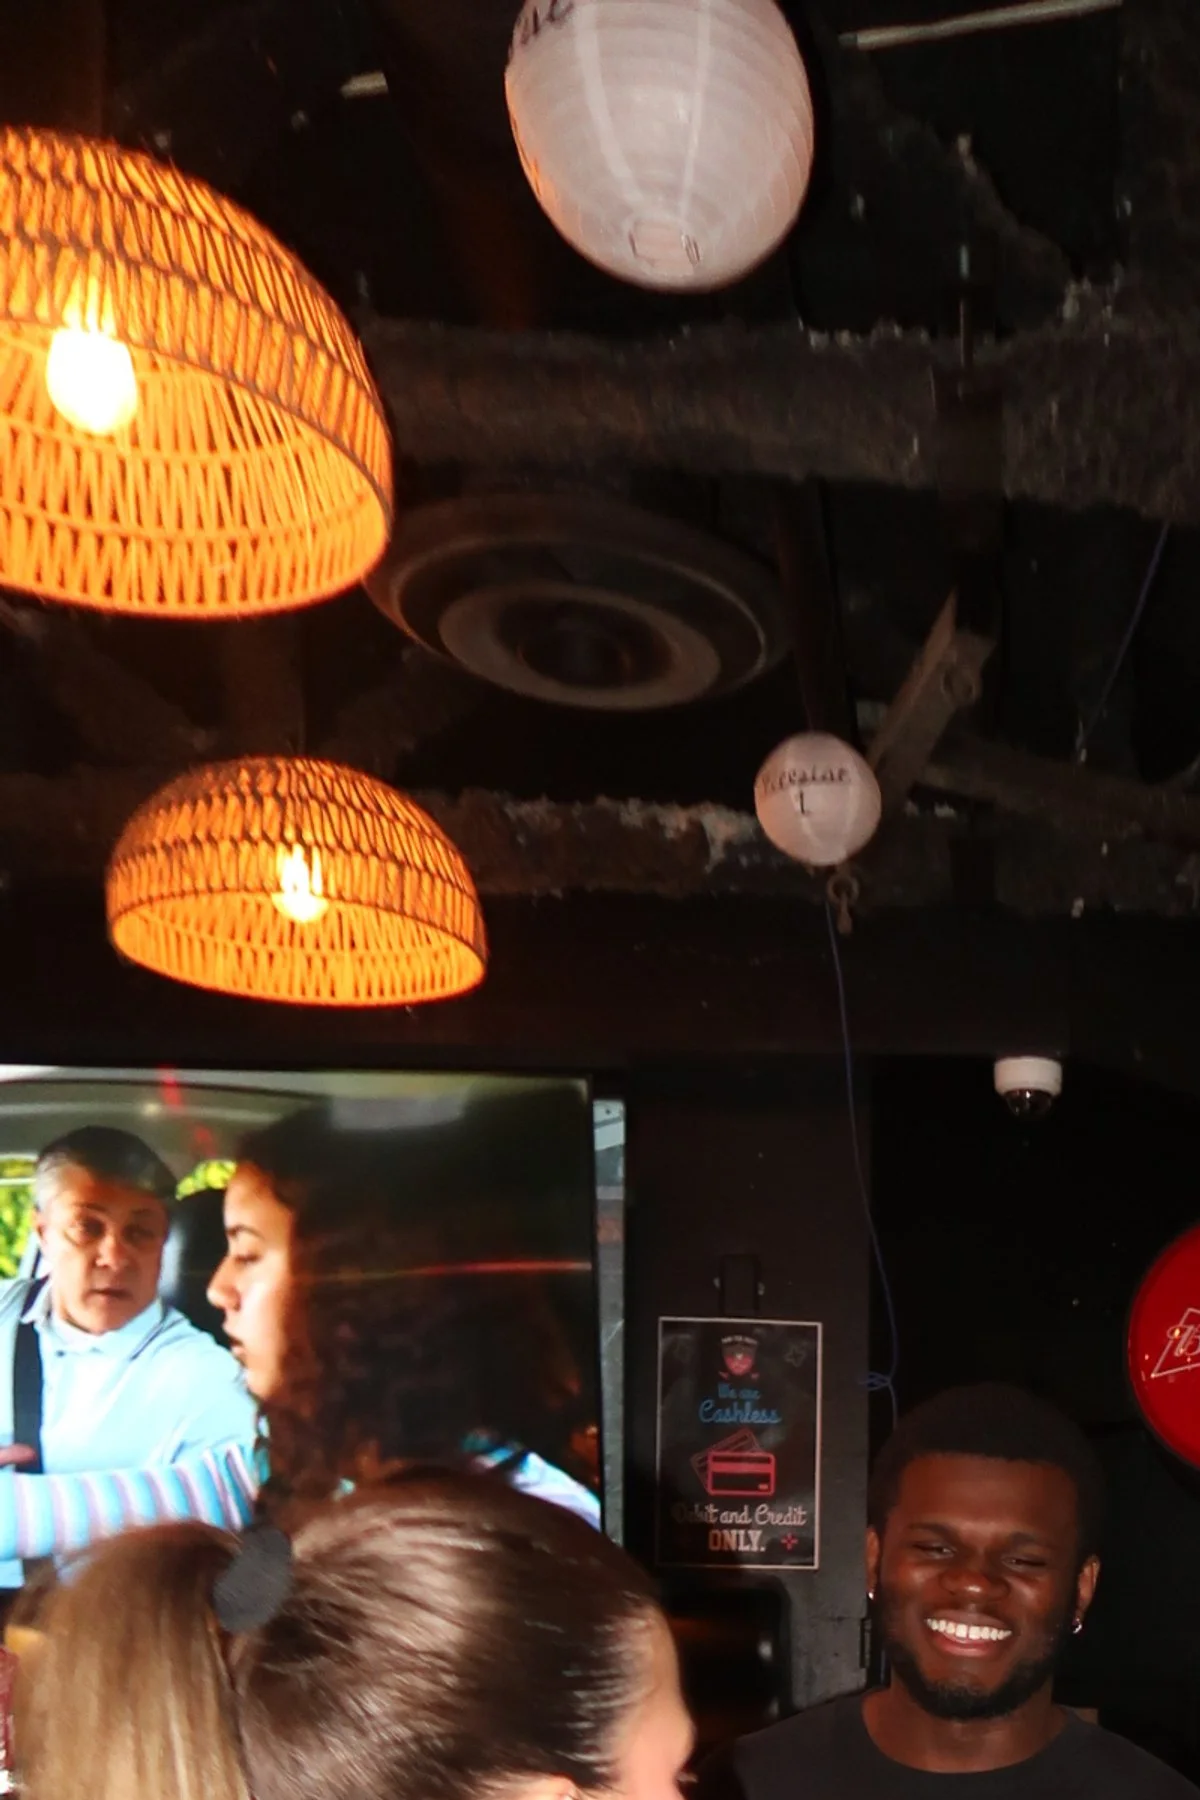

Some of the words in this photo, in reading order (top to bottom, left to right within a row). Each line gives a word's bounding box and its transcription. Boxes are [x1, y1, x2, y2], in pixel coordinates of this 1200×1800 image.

[698, 1399, 782, 1423] Cashless
[720, 1504, 752, 1525] and
[754, 1503, 808, 1526] Credit
[708, 1529, 766, 1552] ONLY.
